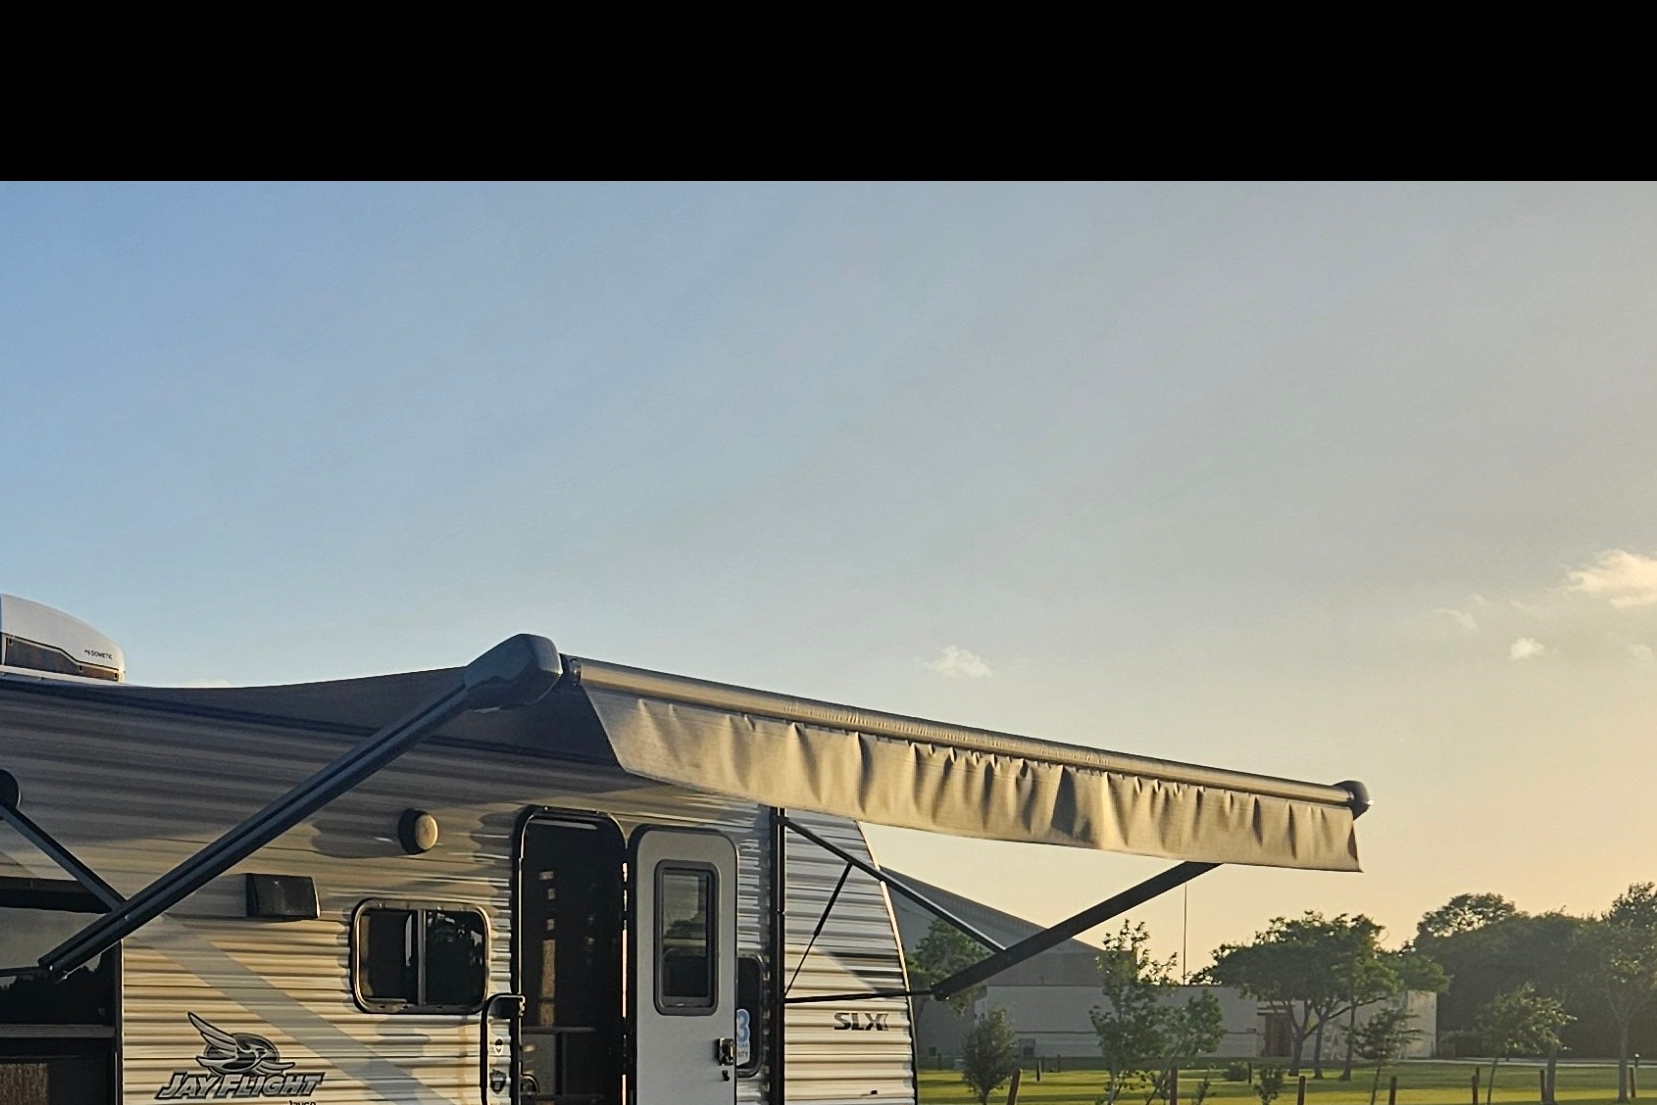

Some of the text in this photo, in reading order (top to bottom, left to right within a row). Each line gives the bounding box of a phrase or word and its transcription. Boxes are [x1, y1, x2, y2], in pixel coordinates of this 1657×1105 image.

[834, 1012, 888, 1031] SLX
[155, 1071, 325, 1100] JAY FLIGHT
